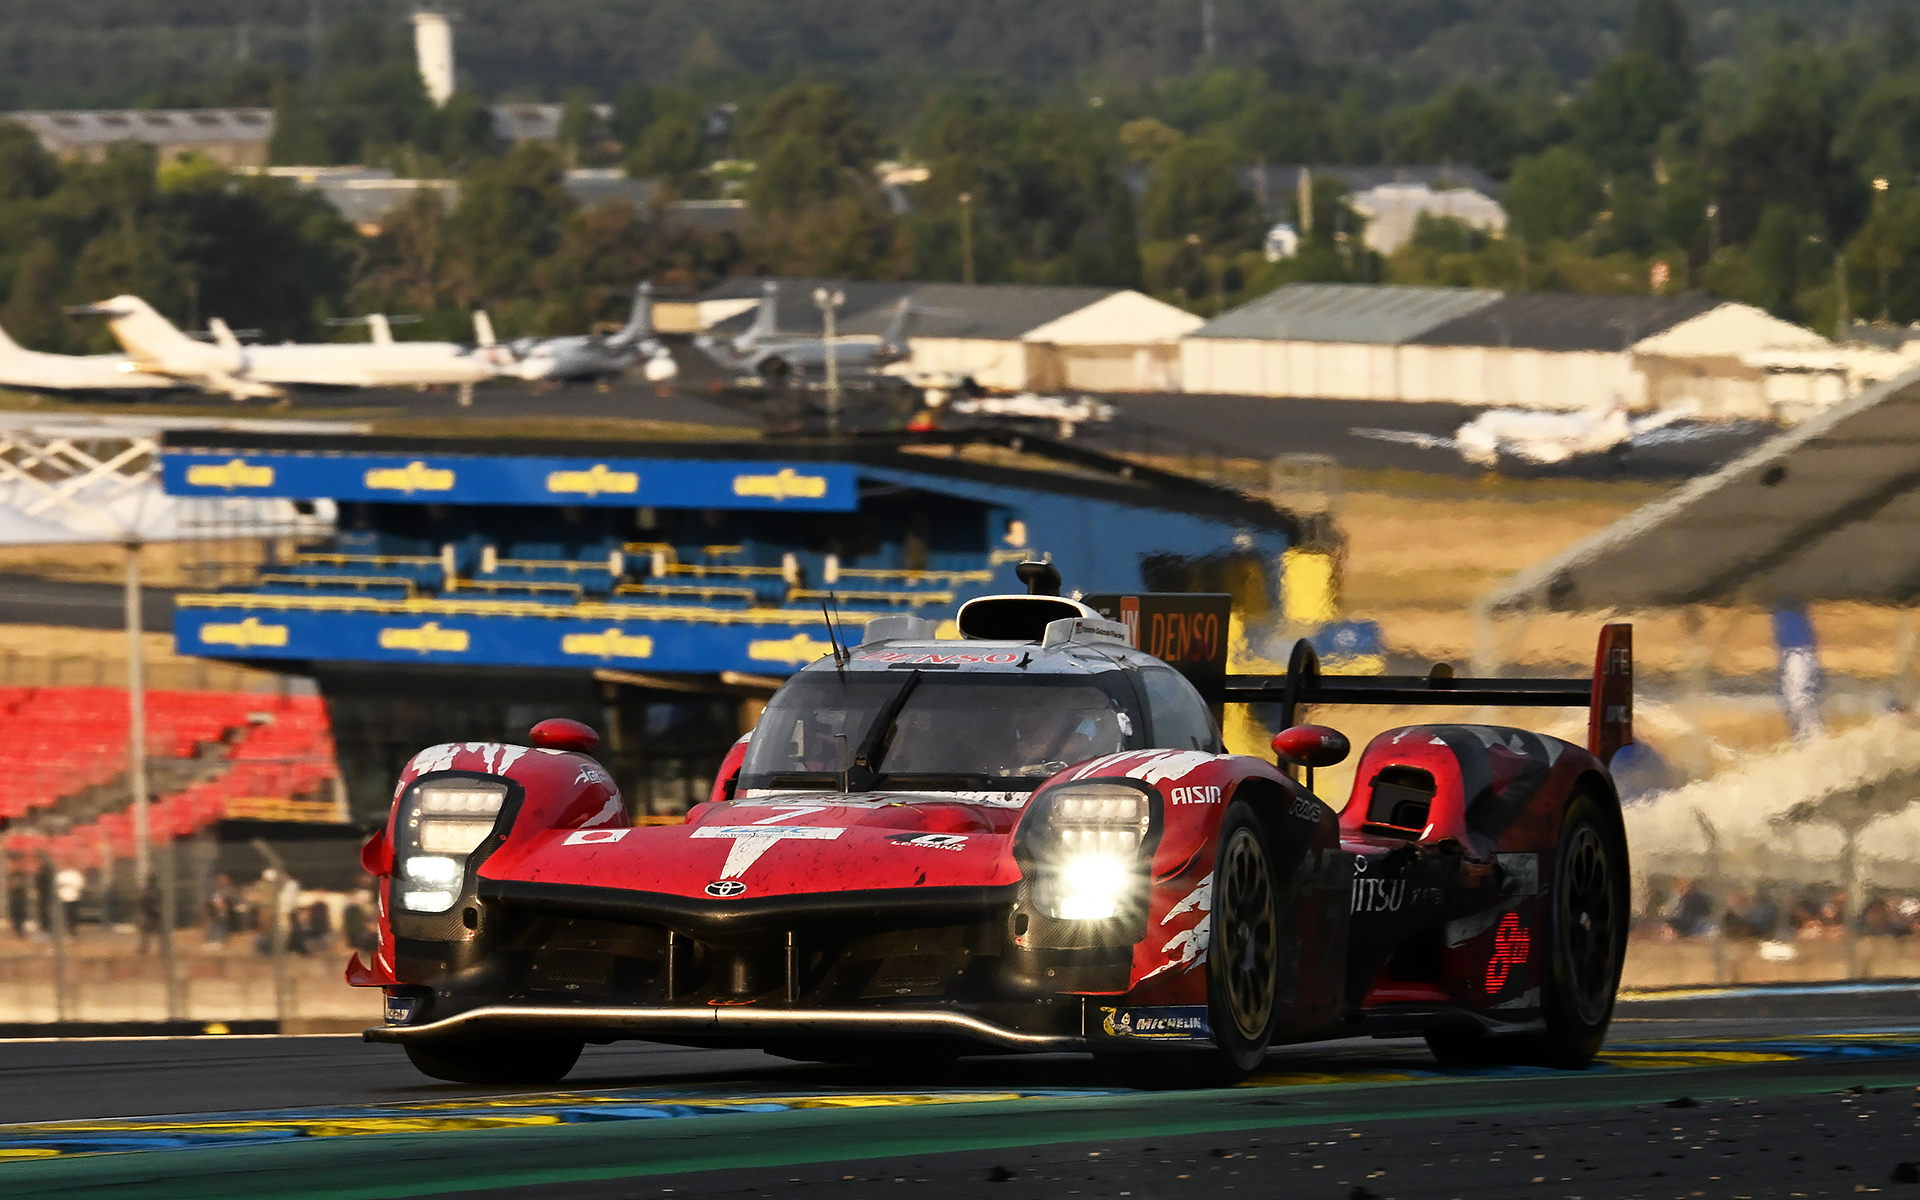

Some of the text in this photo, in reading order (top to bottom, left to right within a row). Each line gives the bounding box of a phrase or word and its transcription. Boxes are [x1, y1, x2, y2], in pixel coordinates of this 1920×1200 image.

[1151, 612, 1218, 661] DENSO
[852, 651, 1019, 664] DENSO
[1170, 785, 1222, 805] AISIN
[751, 806, 828, 825] 7
[1135, 1016, 1202, 1031] MICHELIN
